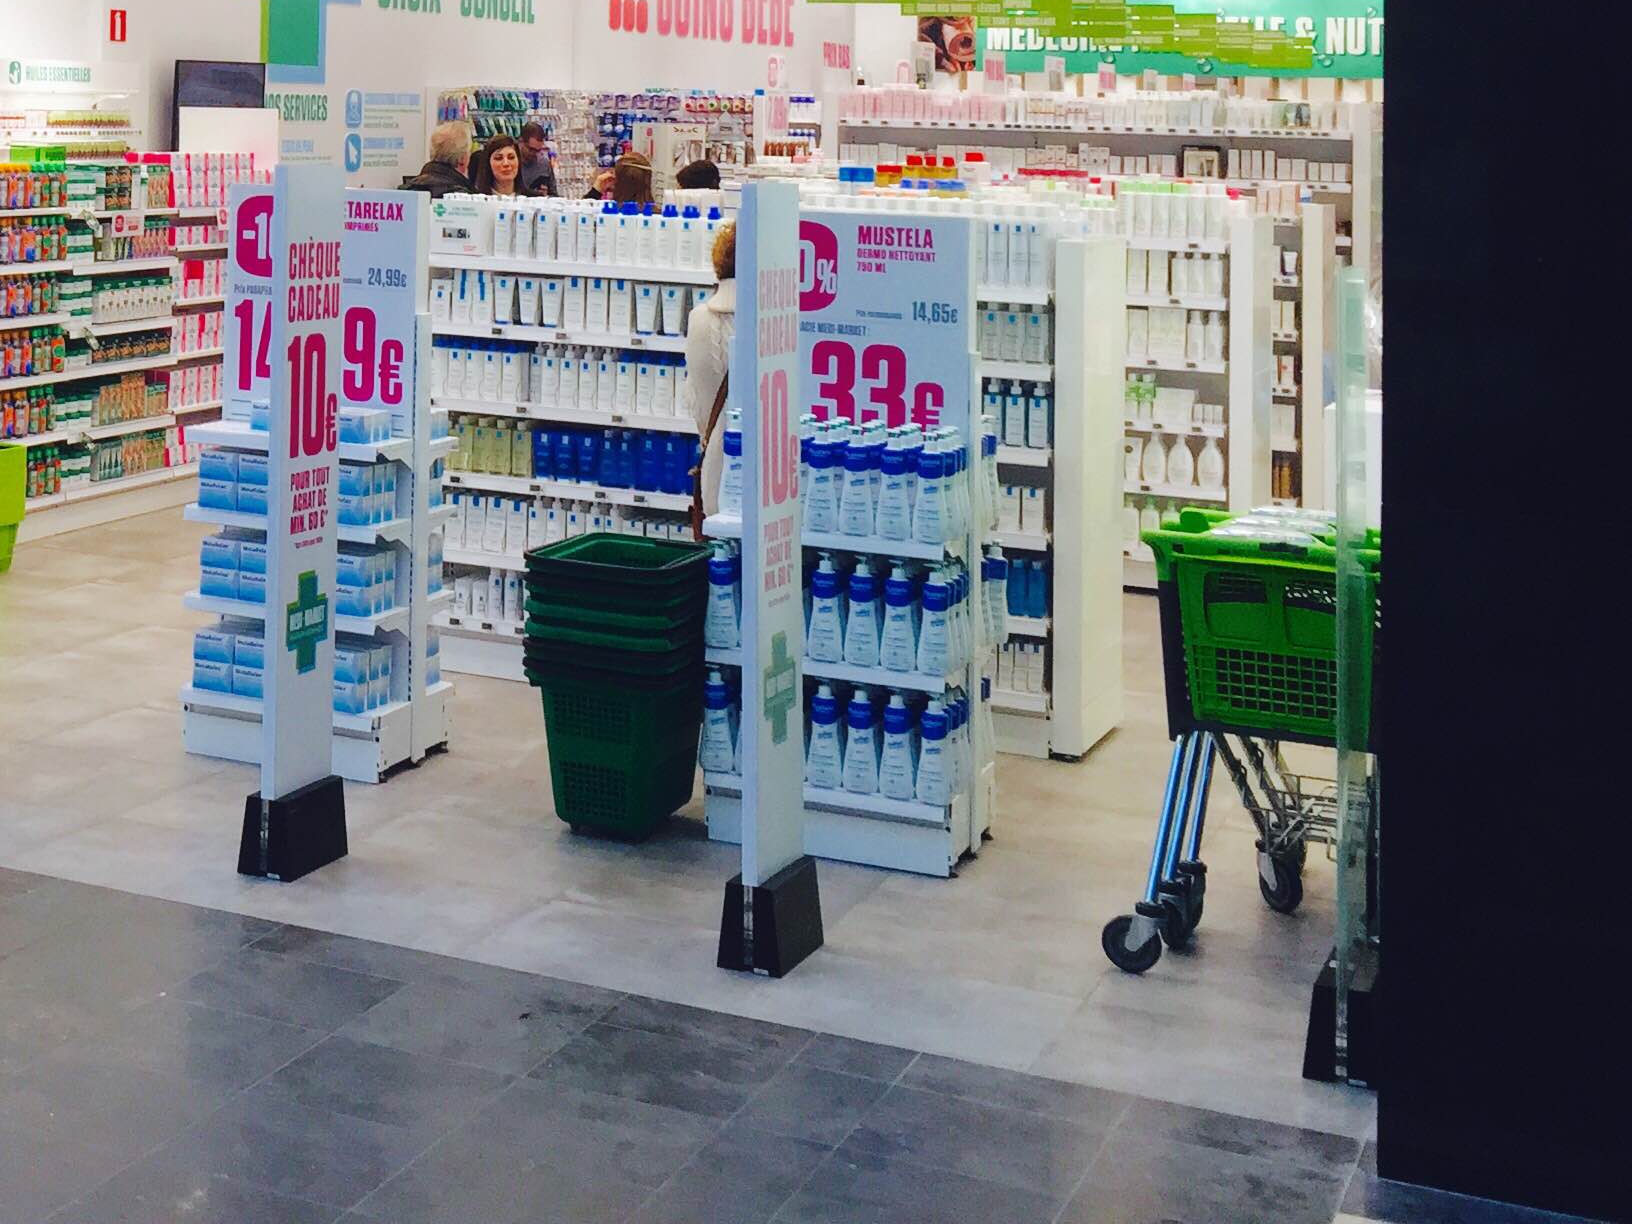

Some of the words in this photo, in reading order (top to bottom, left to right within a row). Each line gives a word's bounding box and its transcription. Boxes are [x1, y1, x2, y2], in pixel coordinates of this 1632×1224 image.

[283, 94, 328, 121] SERVICES
[344, 200, 404, 222] TARELAX
[857, 225, 934, 249] MUSTELA
[288, 236, 341, 281] CHÈQUE
[856, 248, 886, 260] DERMO
[888, 249, 936, 263] NETTOYANT
[856, 261, 873, 273] 750
[875, 262, 887, 273] ML
[367, 267, 407, 288] 24,99€
[287, 283, 340, 324] CADEAU
[911, 300, 959, 325] 14,65€
[287, 332, 337, 459] 10€
